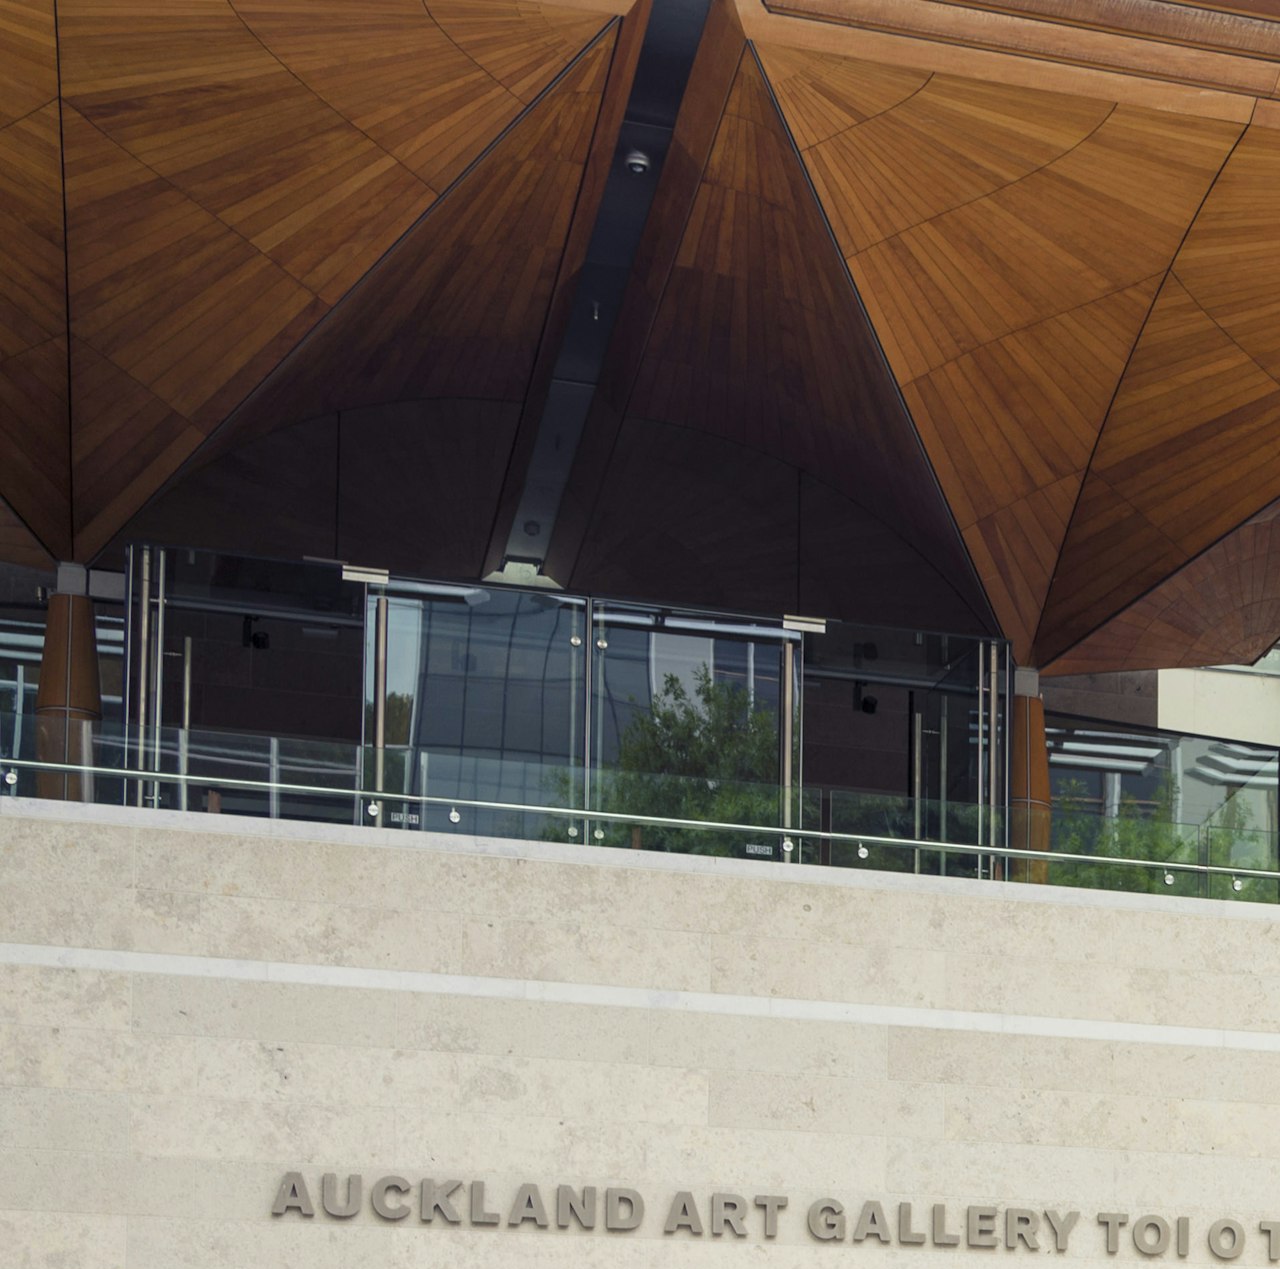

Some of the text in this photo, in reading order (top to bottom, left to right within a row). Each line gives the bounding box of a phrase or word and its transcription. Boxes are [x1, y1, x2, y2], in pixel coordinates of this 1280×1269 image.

[747, 844, 772, 855] PUSH
[271, 1171, 645, 1230] AUCKLAND
[664, 1190, 788, 1238] ART
[806, 1197, 1081, 1253] GALLERY
[1097, 1211, 1190, 1258] TOI
[1207, 1218, 1246, 1260] O
